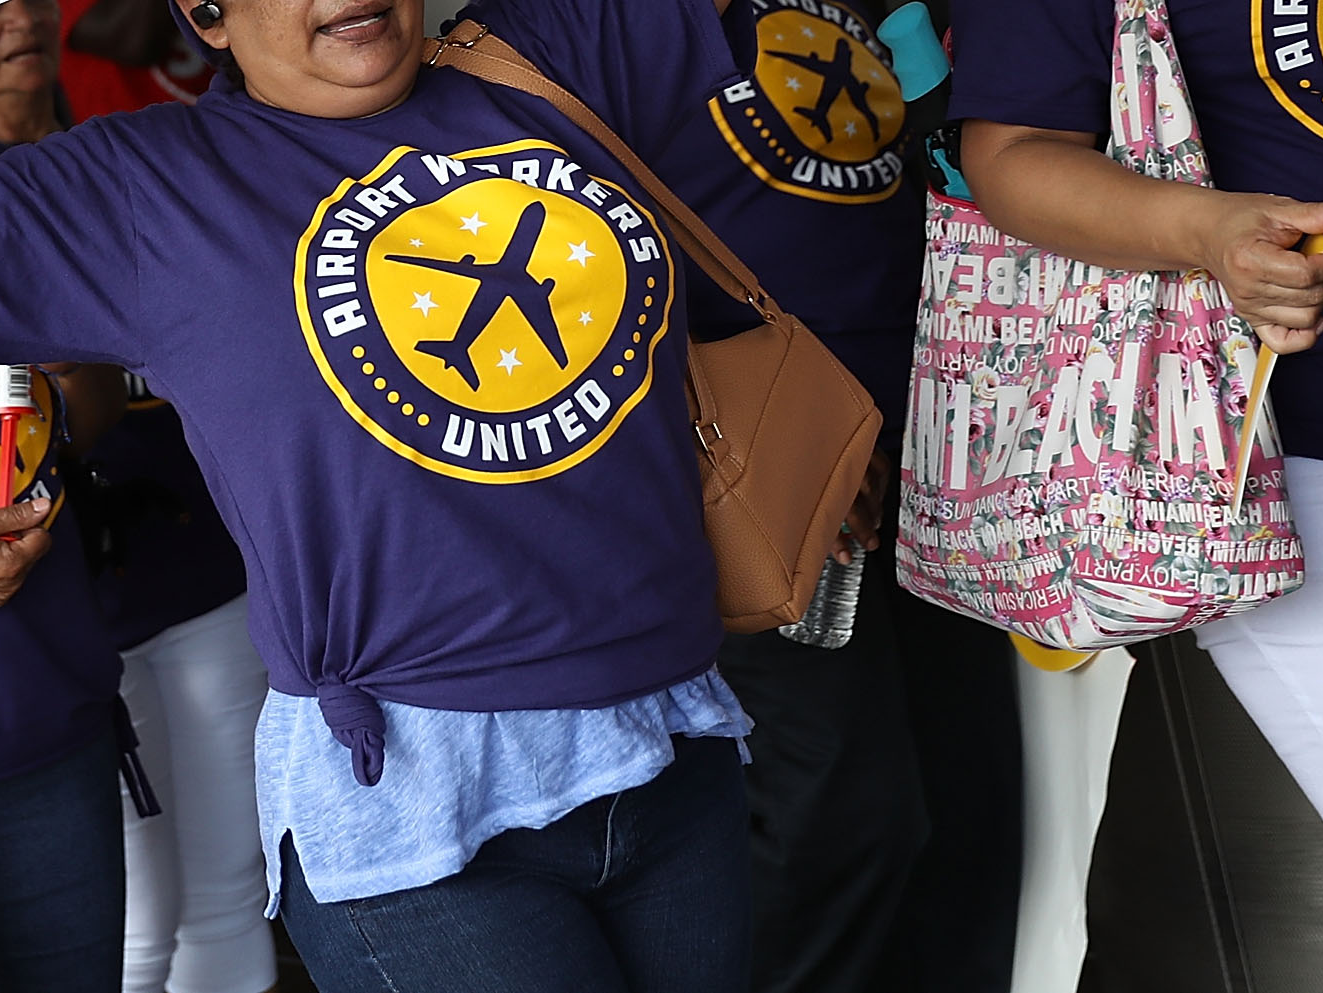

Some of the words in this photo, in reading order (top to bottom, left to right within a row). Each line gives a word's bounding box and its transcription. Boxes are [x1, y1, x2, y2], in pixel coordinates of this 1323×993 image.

[791, 150, 904, 190] UNITED
[316, 175, 417, 338] AIRPORT
[420, 153, 661, 264] WRKERS
[441, 379, 611, 462] UNITED
